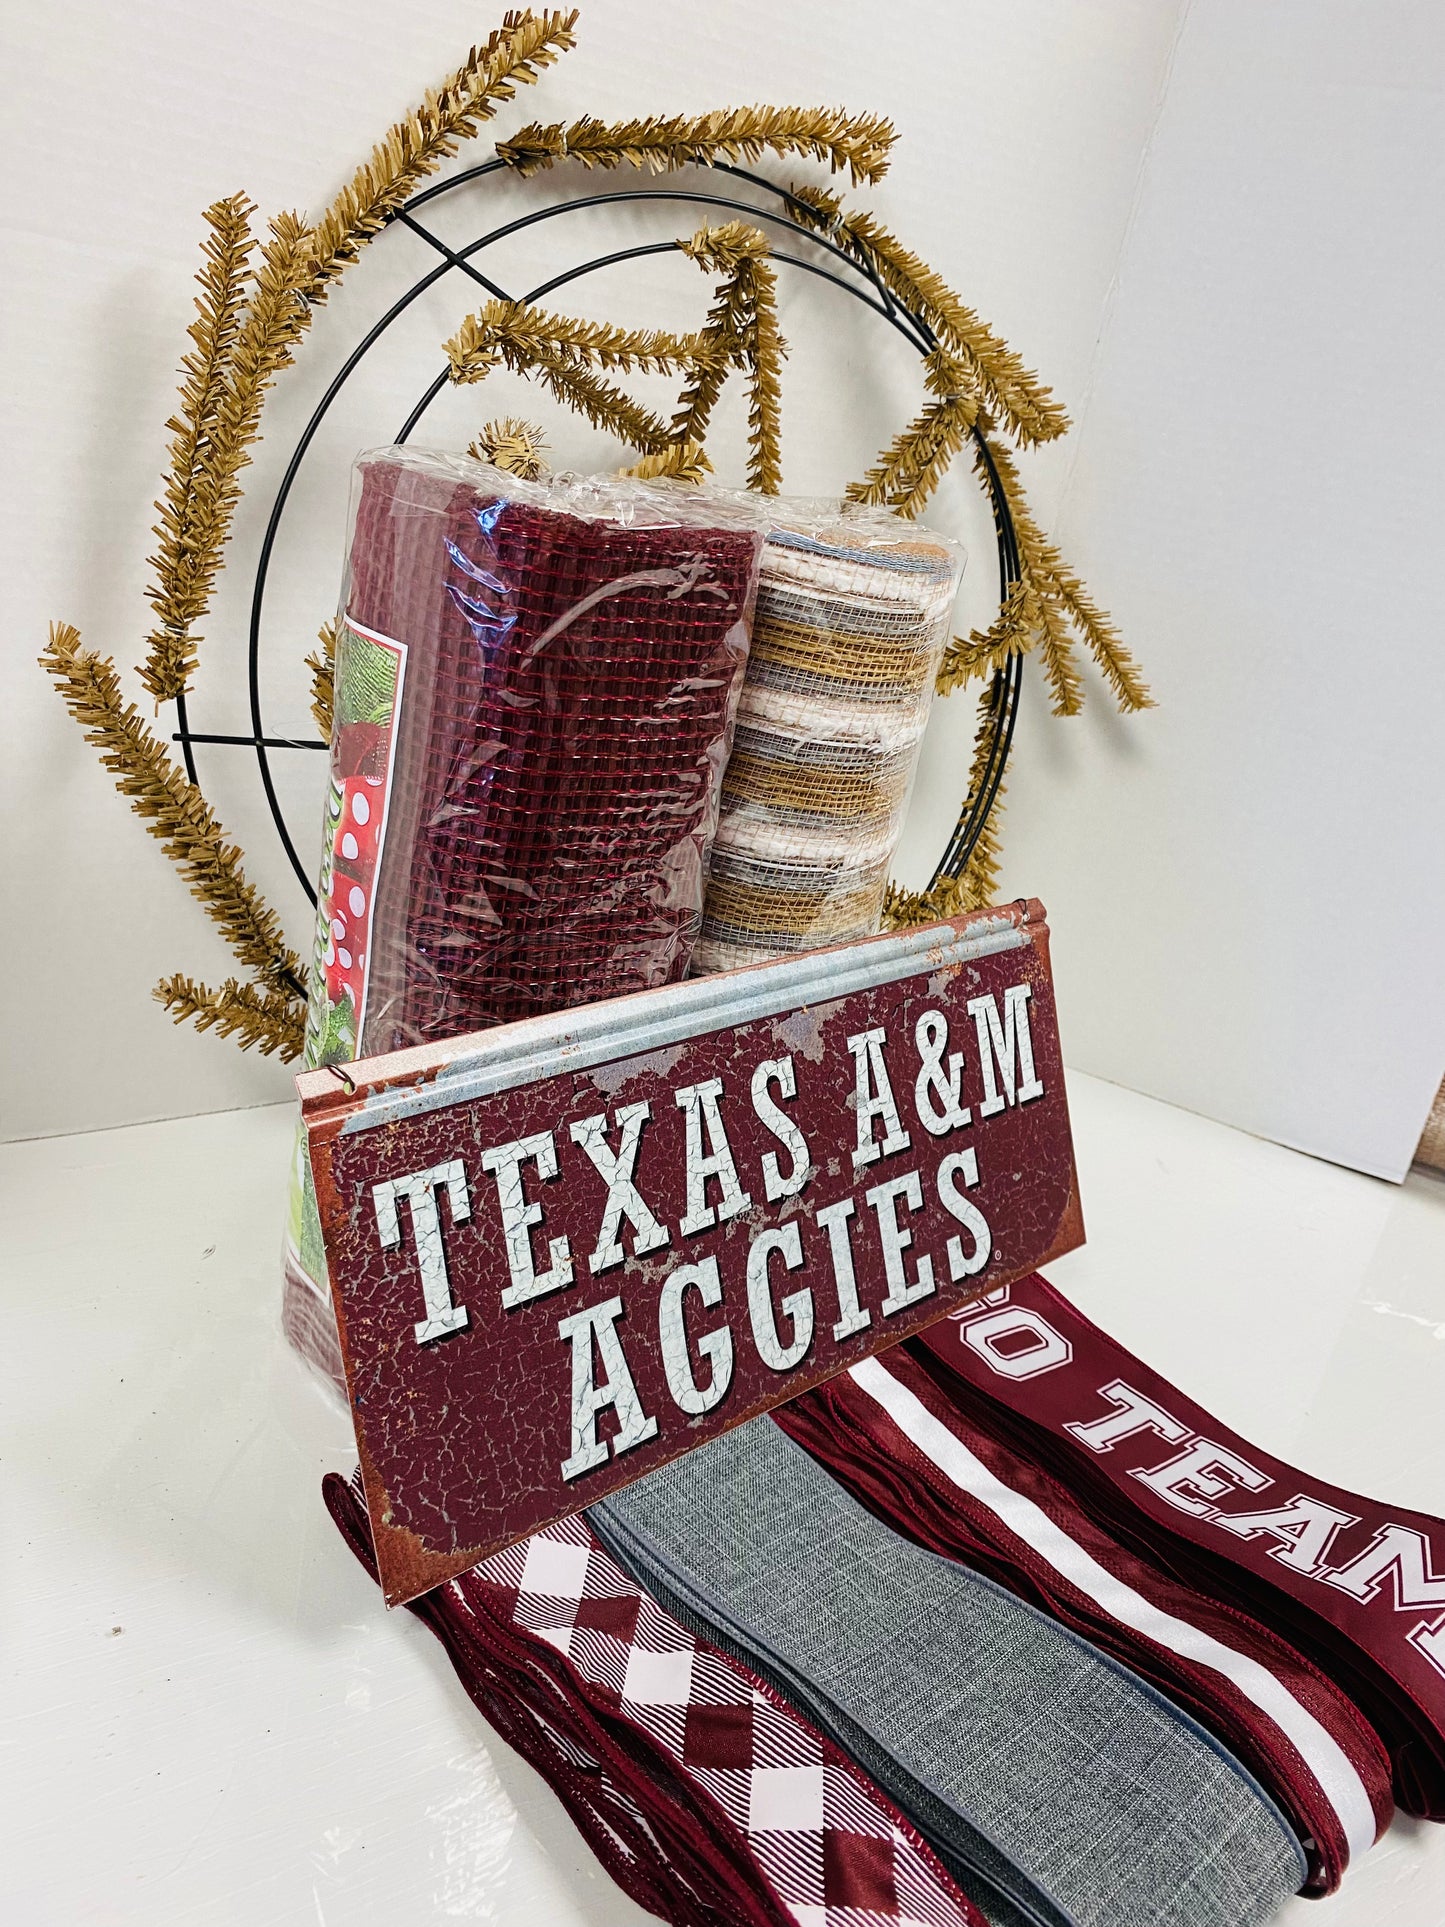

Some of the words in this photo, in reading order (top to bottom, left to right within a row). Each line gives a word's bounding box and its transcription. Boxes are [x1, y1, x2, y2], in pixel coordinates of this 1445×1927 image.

[372, 1056, 813, 1346] TEXAS
[846, 983, 1046, 1167] A&M
[559, 1146, 995, 1482] AGGIES
[947, 1283, 1074, 1381] O
[1062, 1377, 1445, 1680] TEAM
